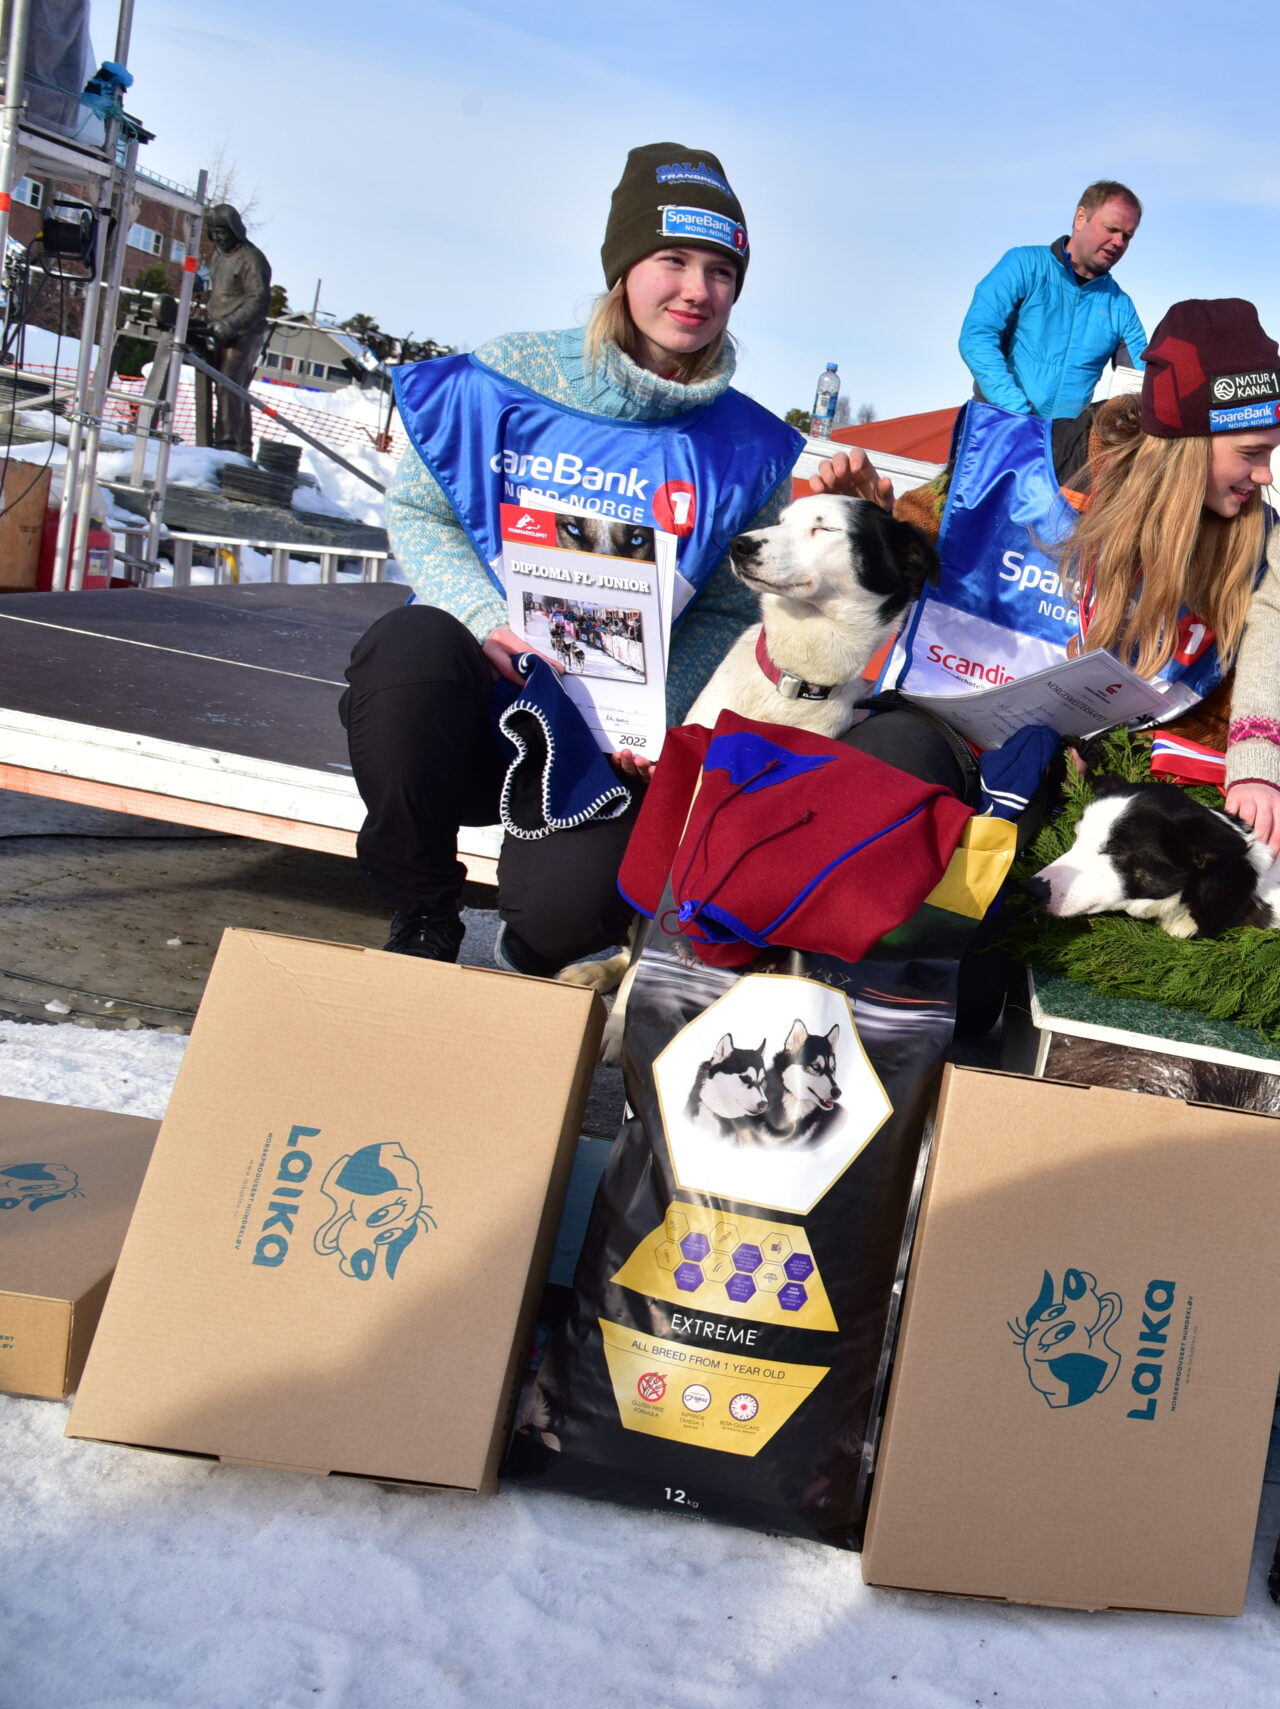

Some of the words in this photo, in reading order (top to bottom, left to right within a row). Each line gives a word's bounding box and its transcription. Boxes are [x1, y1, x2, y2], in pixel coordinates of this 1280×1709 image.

[667, 211, 732, 233] SpareBank
[685, 225, 732, 242] NORD-NORGE
[1235, 373, 1271, 387] NATUR
[1237, 384, 1273, 399] KANAL
[1211, 406, 1272, 424] SpareBank
[1228, 417, 1274, 429] NORD-NORGE
[670, 490, 692, 525] 1
[511, 560, 572, 583] DIPLOMA
[596, 574, 650, 594] JUNIOR
[619, 735, 648, 748] 2022
[252, 1125, 322, 1268] Laika
[671, 1313, 758, 1346] EXTREME
[631, 1340, 649, 1353] ALL
[651, 1346, 687, 1362] BREED
[688, 1355, 721, 1370] FROM
[733, 1363, 761, 1377] YEAR
[763, 1367, 786, 1380] OLD
[1126, 1279, 1177, 1421] Laika
[633, 1407, 659, 1418] FORMULA
[664, 1487, 686, 1504] 12
[687, 1499, 699, 1509] kg
